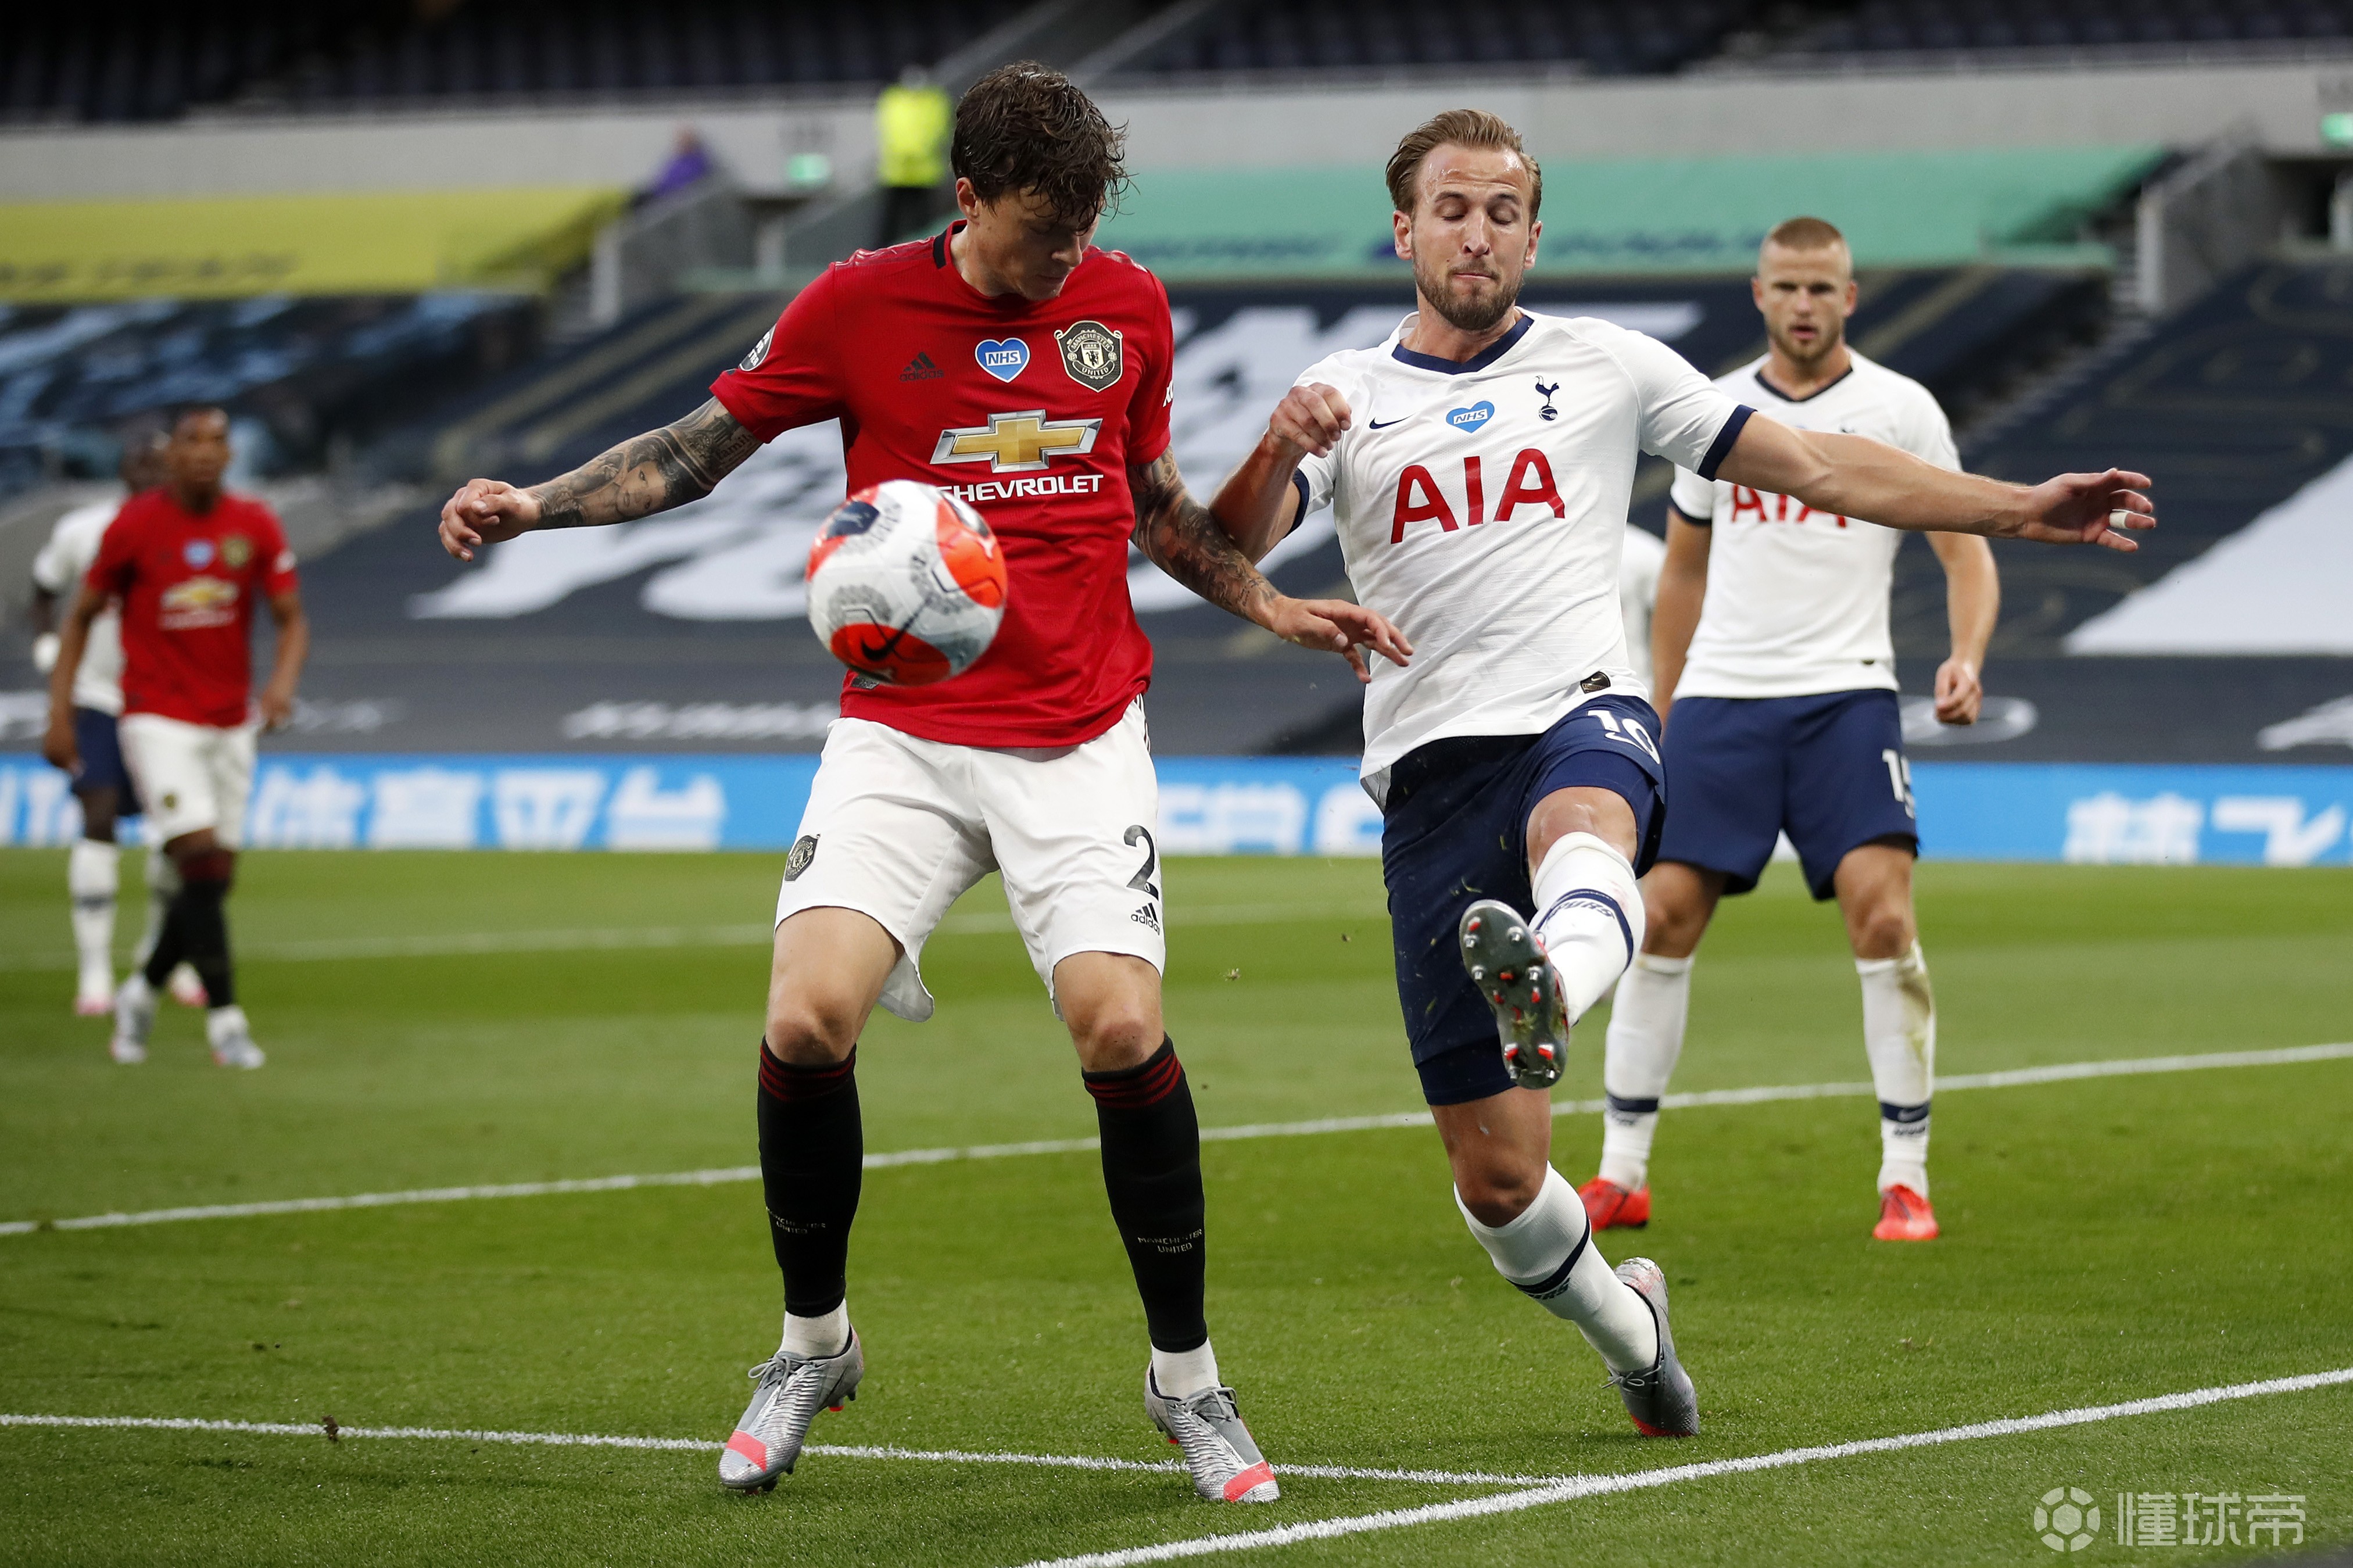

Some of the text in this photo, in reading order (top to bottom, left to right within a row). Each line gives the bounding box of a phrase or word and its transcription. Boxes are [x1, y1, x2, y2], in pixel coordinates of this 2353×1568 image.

[1070, 333, 1111, 350] MANCHESTER
[988, 352, 1018, 364] NHS
[899, 369, 944, 382] adidas
[1081, 367, 1109, 376] UNITED
[1455, 410, 1485, 423] NHS
[1391, 448, 1565, 544] AIA
[1587, 710, 1661, 764] 10
[1123, 825, 1159, 901] 2
[1157, 1243, 1192, 1254] UNITED
